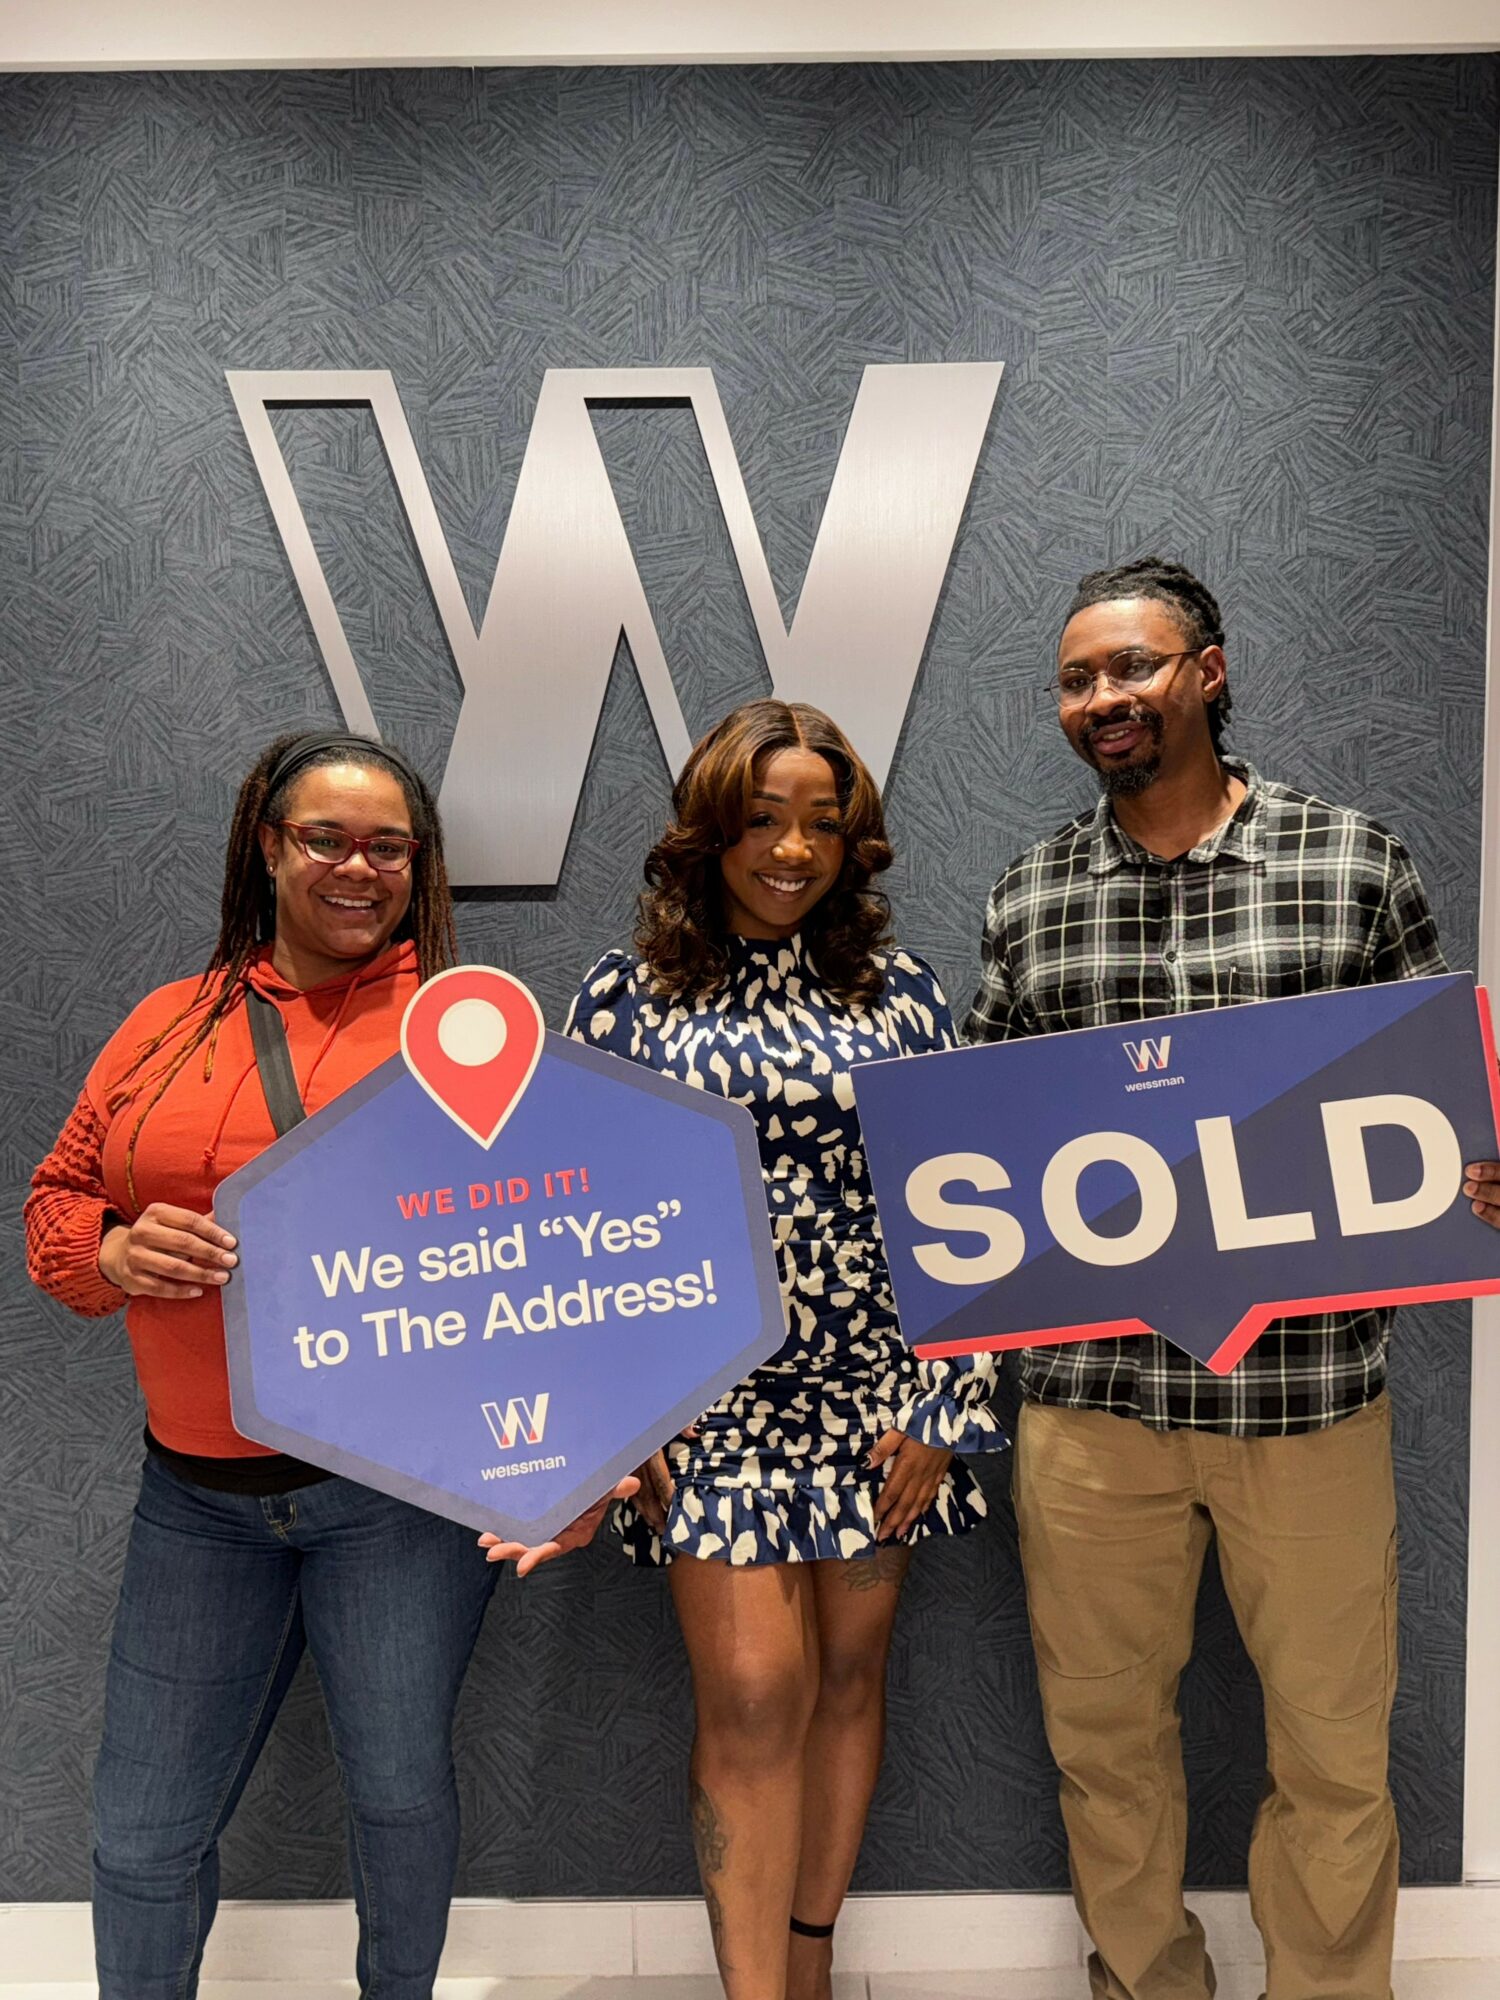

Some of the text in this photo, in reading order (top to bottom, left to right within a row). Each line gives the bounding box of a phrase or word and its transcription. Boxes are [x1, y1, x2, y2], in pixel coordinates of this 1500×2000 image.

[225, 361, 1005, 886] W
[1122, 1035, 1172, 1072] W
[1124, 1076, 1185, 1093] weissman
[397, 1166, 590, 1220] WE DID IT!
[905, 1094, 1462, 1285] SOLD
[311, 1199, 681, 1298] We said “Yes”
[293, 1259, 718, 1369] to The Address!
[480, 1392, 550, 1450] W
[480, 1455, 567, 1481] weissman
